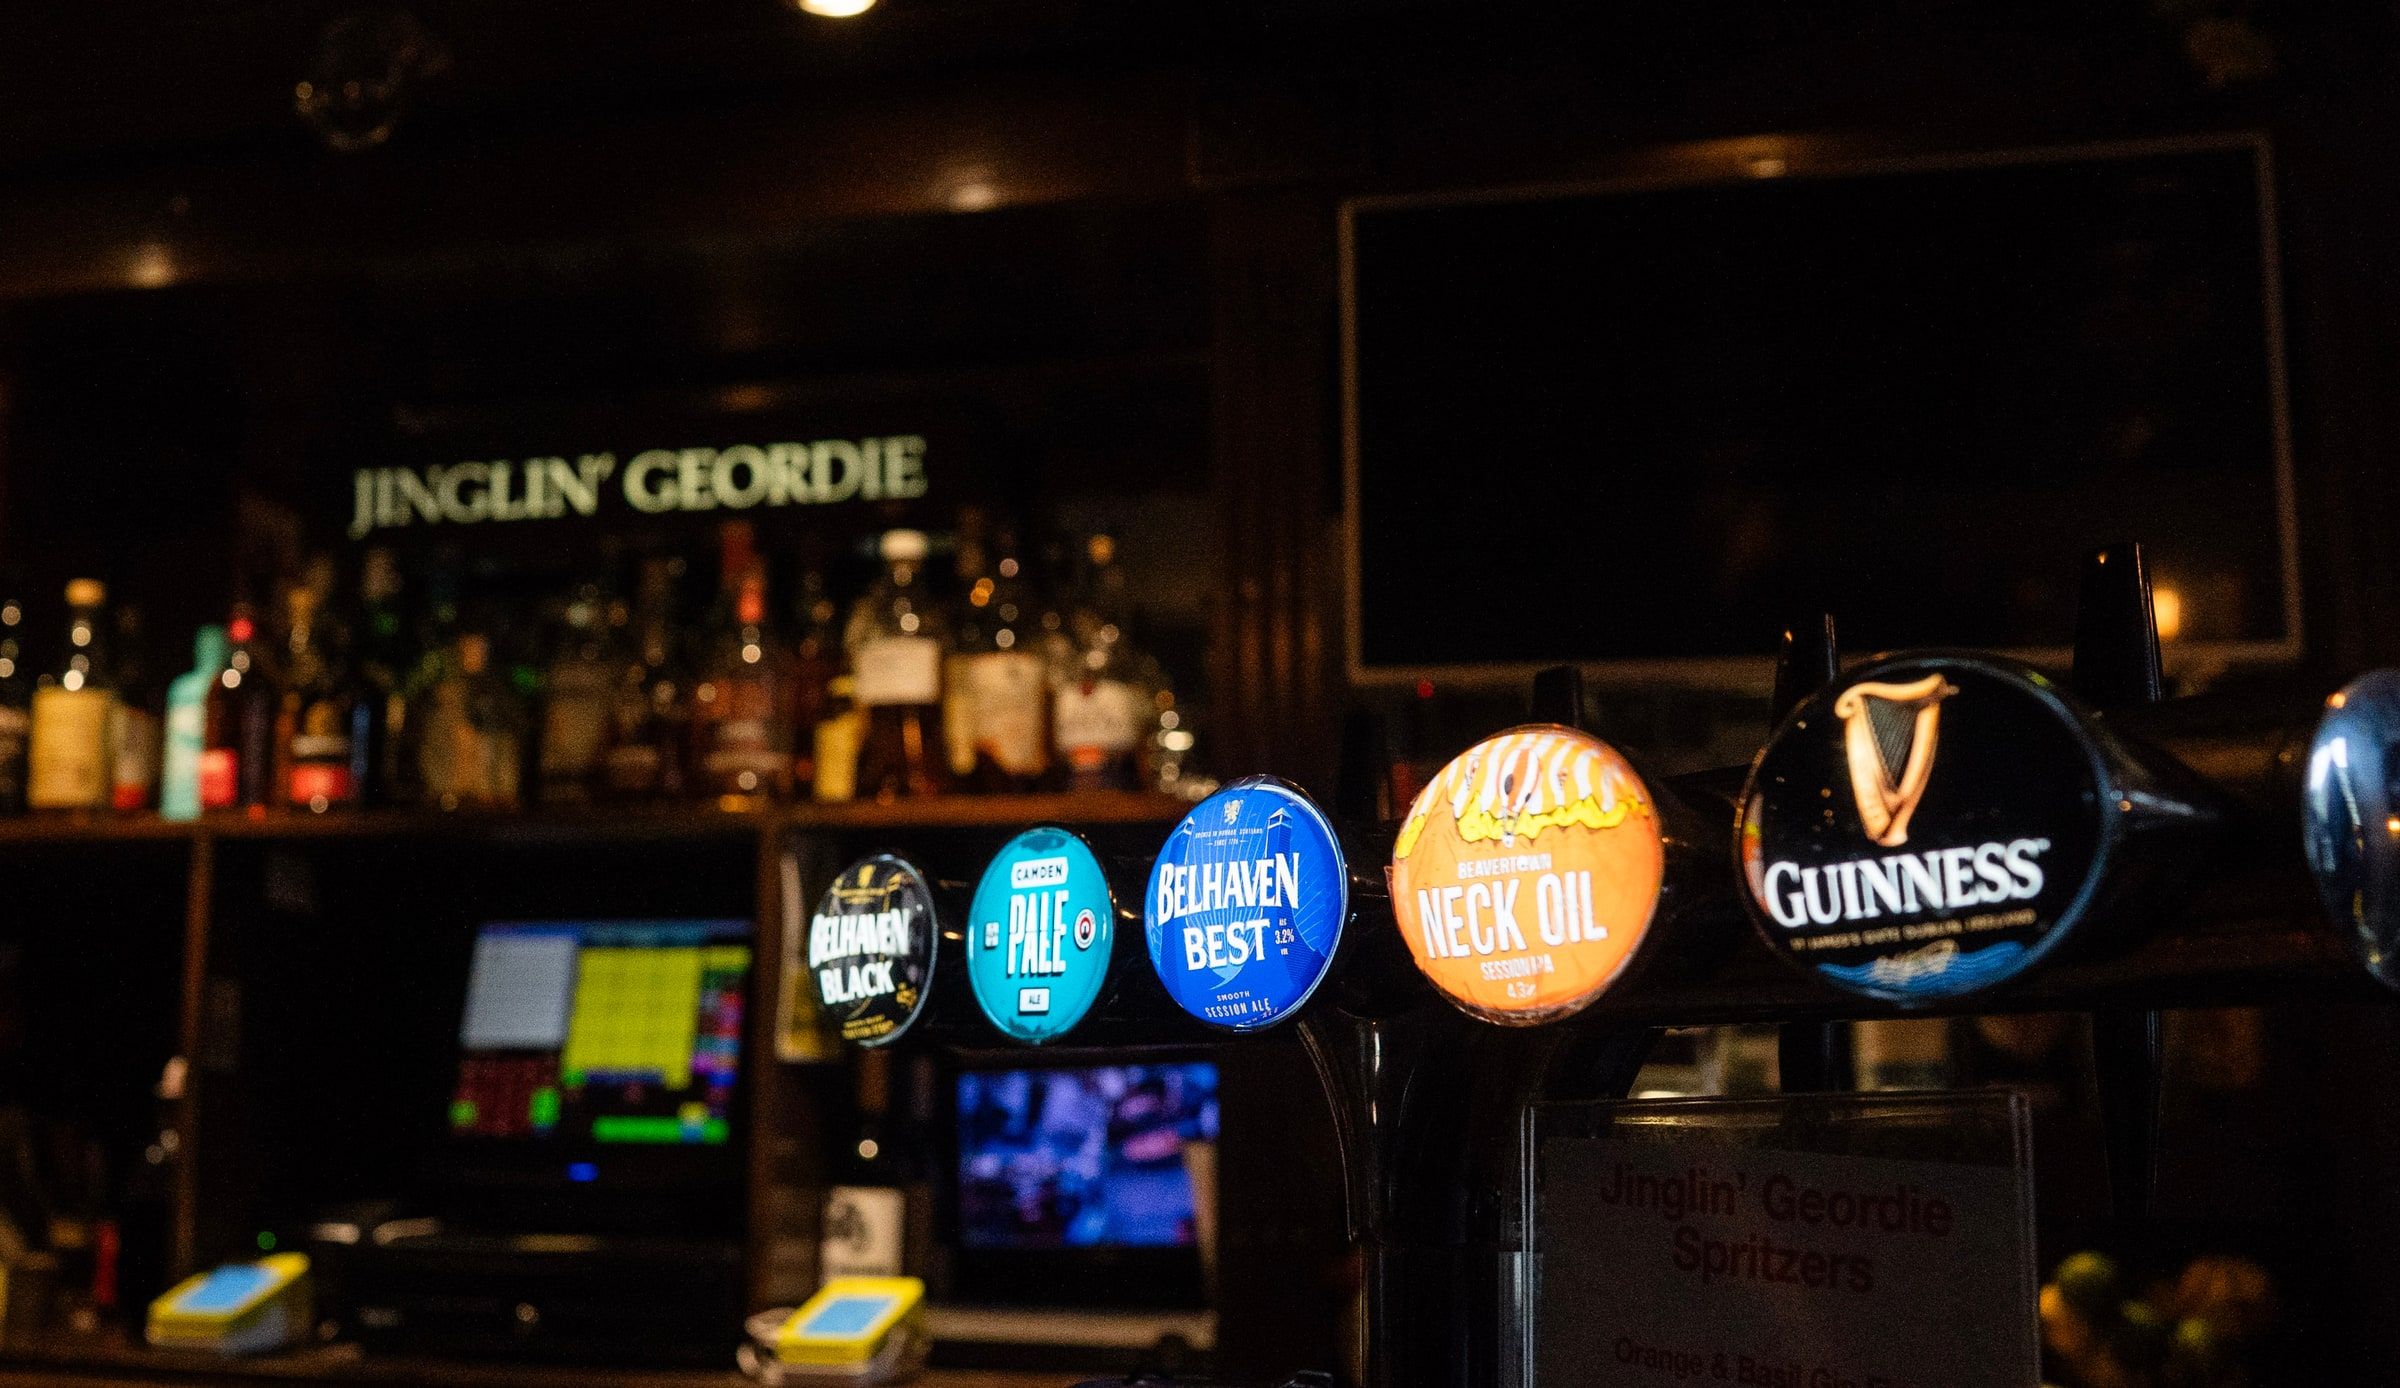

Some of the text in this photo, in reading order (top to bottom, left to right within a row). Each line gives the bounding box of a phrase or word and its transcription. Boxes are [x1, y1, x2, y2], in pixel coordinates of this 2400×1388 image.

[622, 434, 928, 513] GEORDIE
[1016, 864, 1063, 881] CAMDEN
[1158, 852, 1300, 926] BELHAVEN
[1458, 853, 1552, 880] BEAVERTOWN
[1764, 837, 2045, 928] GUINNESS
[809, 907, 912, 968] BELHAVEN
[1007, 889, 1070, 975] PALE
[1274, 928, 1295, 945] 3.2%
[1417, 870, 1608, 960] NECK OIL
[1184, 918, 1270, 971] BEST
[1480, 953, 1554, 981] SESSION IPA
[819, 960, 897, 1004] BLACK
[1204, 997, 1272, 1018] SESSION ALE
[1216, 990, 1250, 1002] SMOOTH
[1600, 1162, 1954, 1237] Jinglin' Geordie
[1673, 1225, 1875, 1293] Spritzers
[1614, 1336, 1704, 1379] Orange
[1710, 1352, 1728, 1380] &
[1737, 1356, 1802, 1388] Basil
